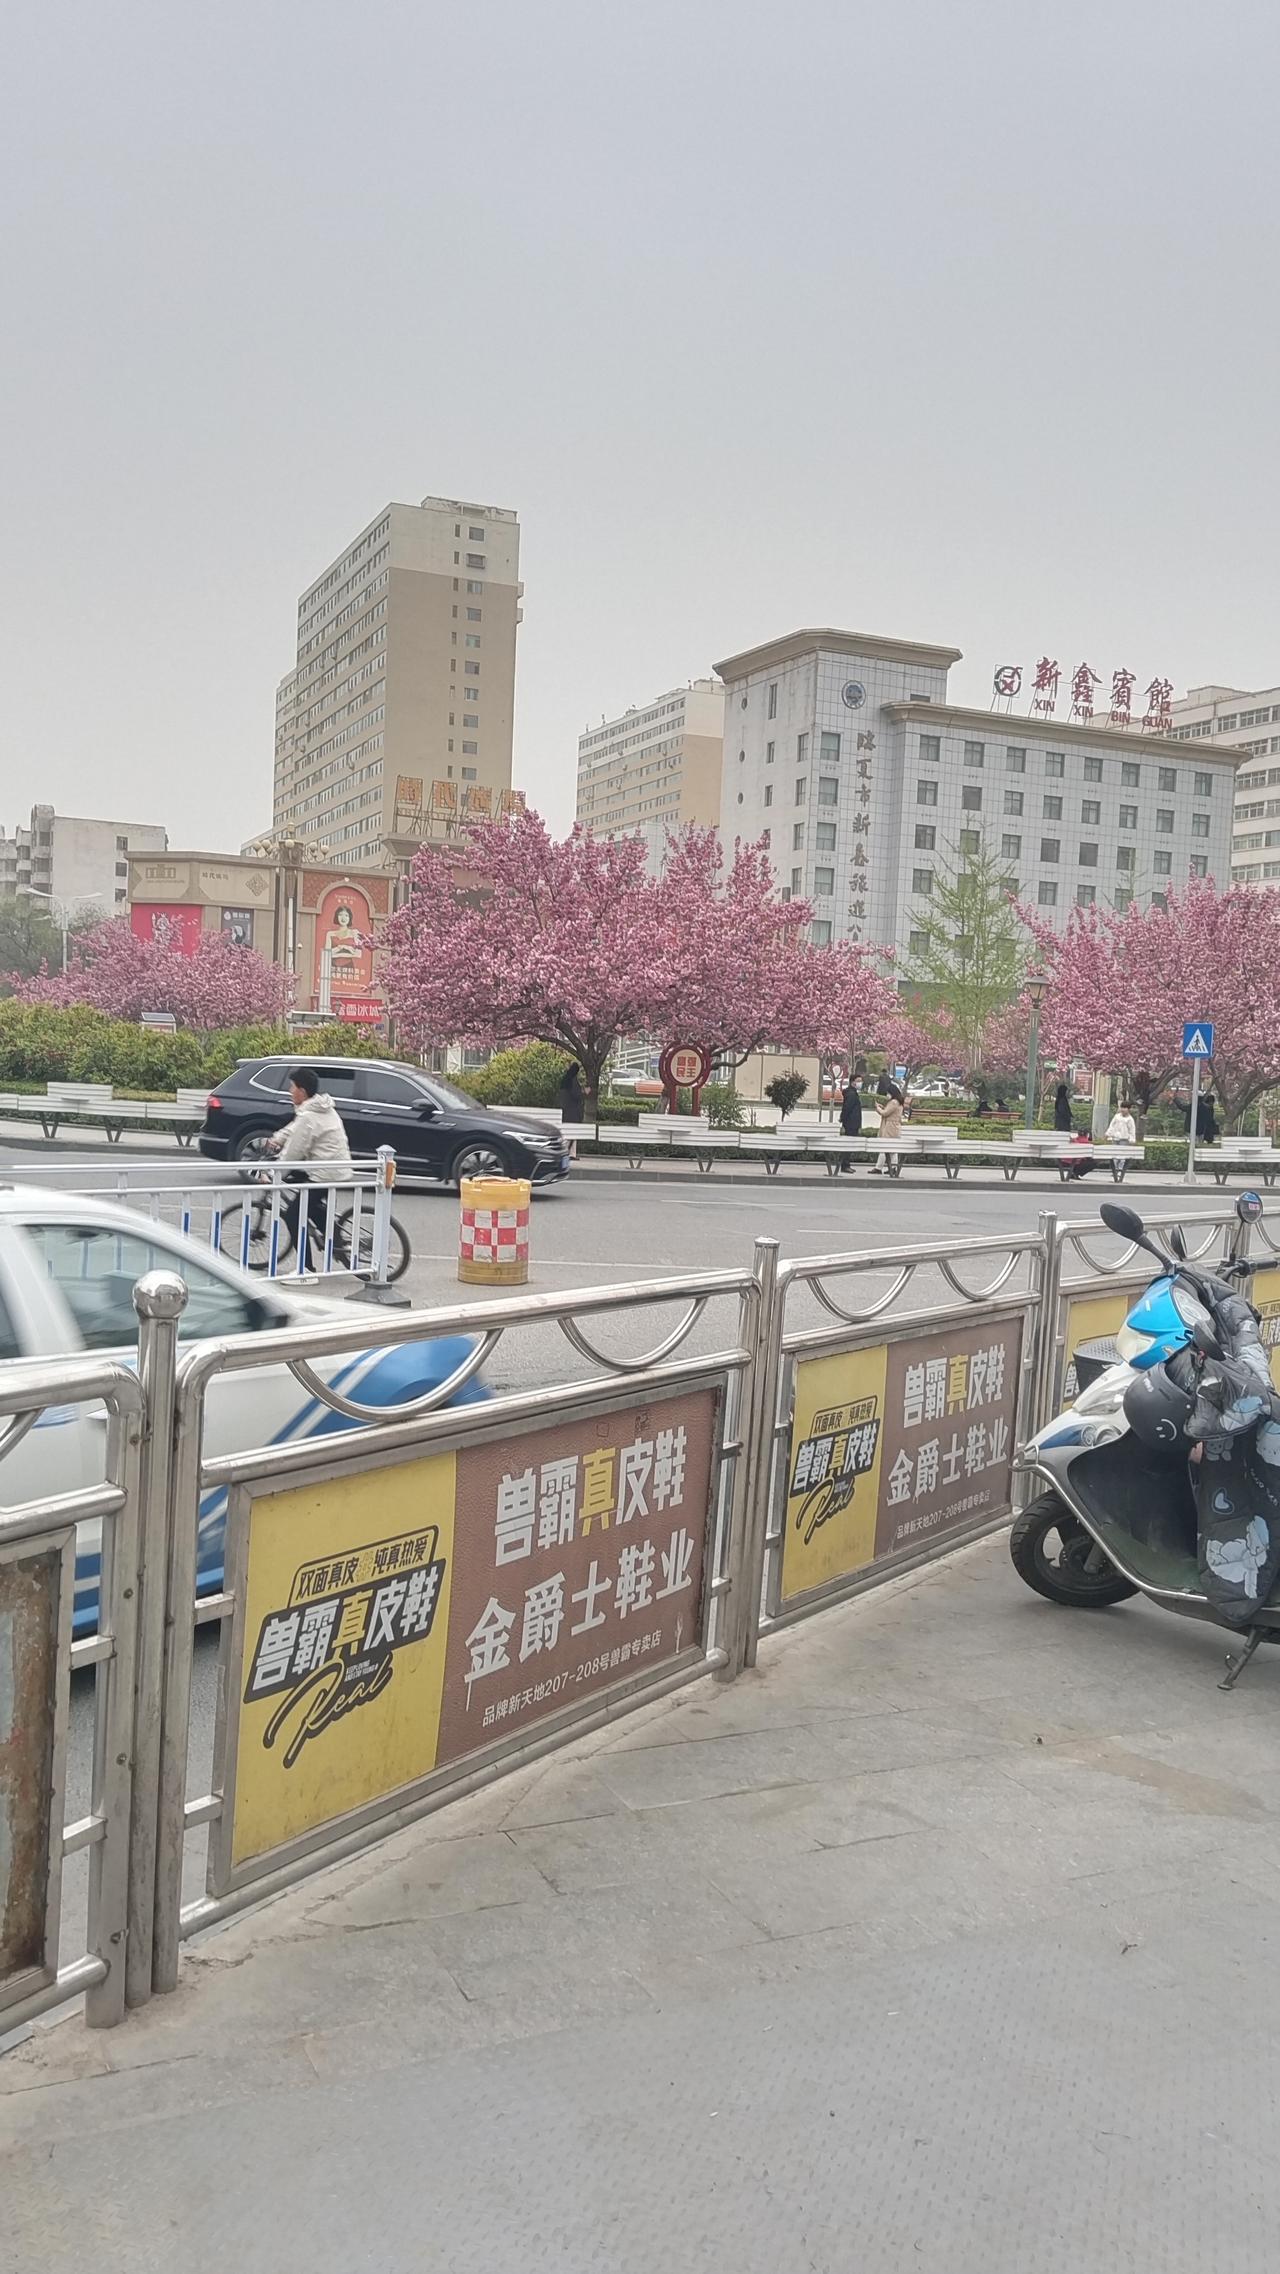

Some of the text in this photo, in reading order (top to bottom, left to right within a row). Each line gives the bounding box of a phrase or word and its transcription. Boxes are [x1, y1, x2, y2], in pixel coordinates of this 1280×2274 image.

[1034, 698, 1173, 729] XIN XIN BIN GUAN
[814, 1410, 844, 1434] 双面真皮
[903, 1343, 1006, 1429] 兽霸真皮鞋
[494, 1425, 687, 1567] 兽霸真皮鞋
[793, 1422, 877, 1491] 兽霸真皮鞋
[886, 1417, 1009, 1507] 金爵士鞋业
[296, 1535, 429, 1600] 双面真皮 纯真热爱
[464, 1527, 696, 1683] 金爵士鞋业
[252, 1566, 438, 1690] 兽霸真皮鞋
[264, 1651, 393, 1768] Real
[482, 1630, 662, 1728] 品牌新天地207-208号兽霸专卖店
